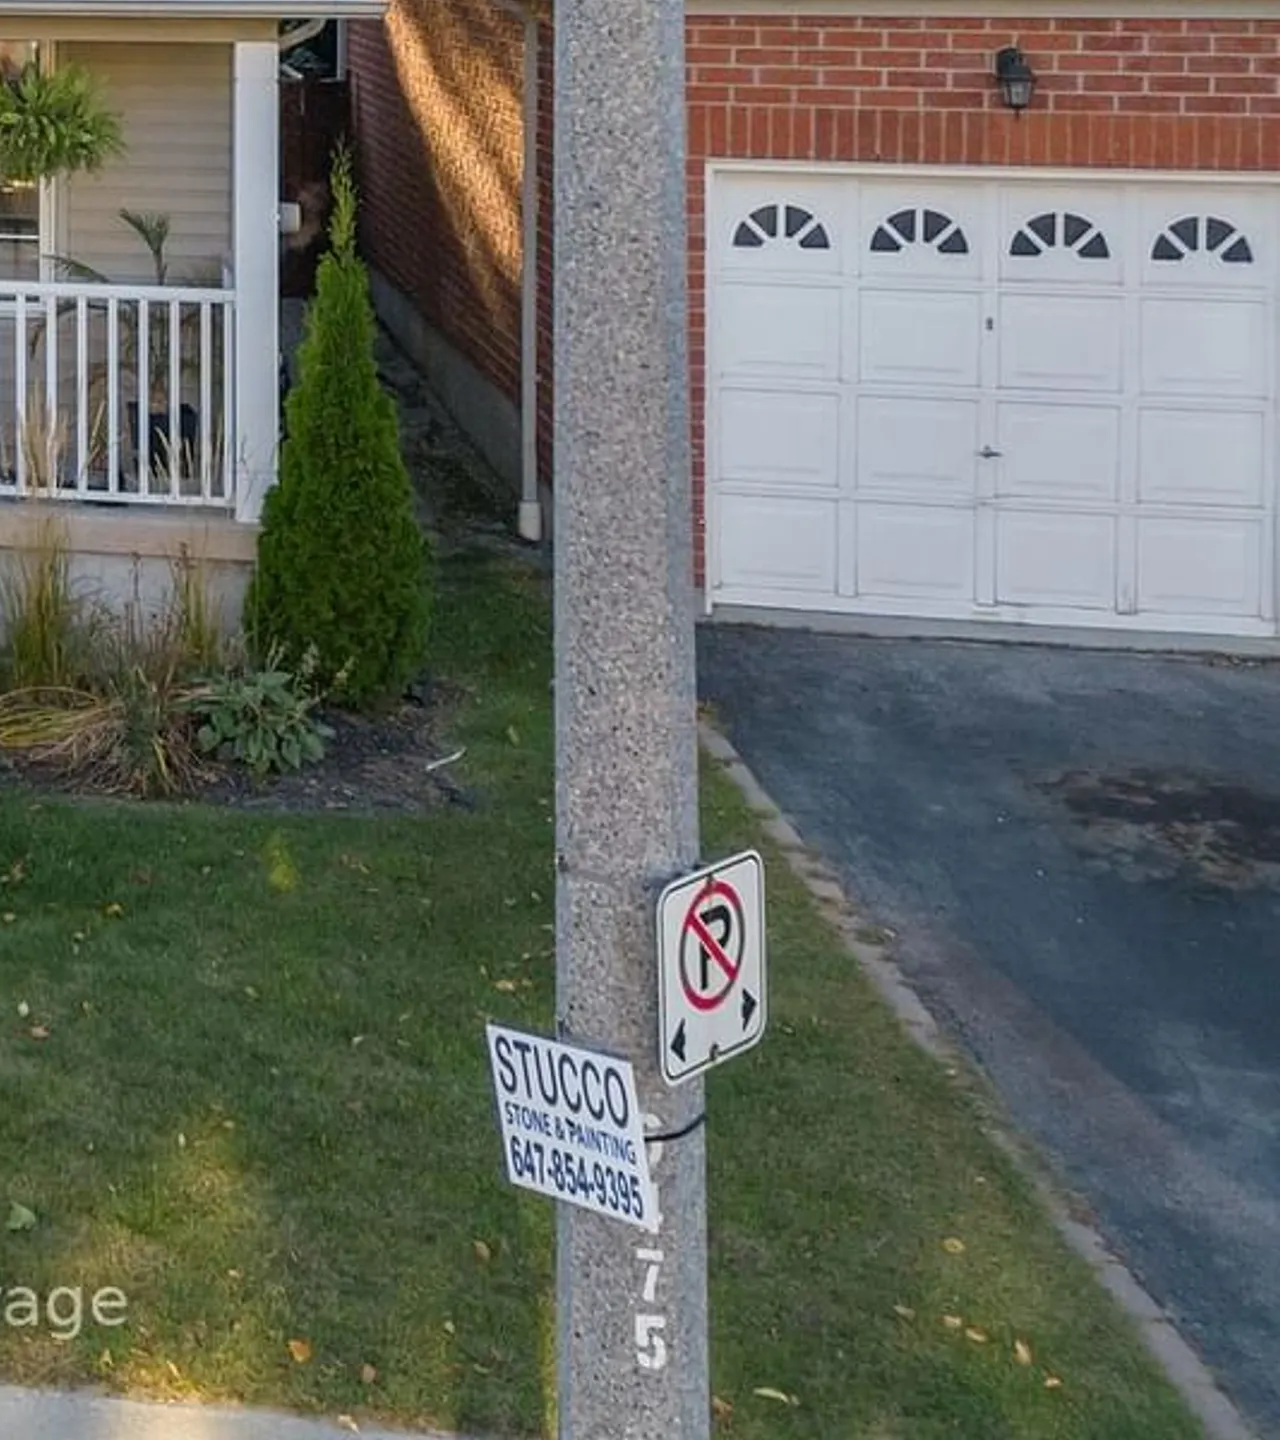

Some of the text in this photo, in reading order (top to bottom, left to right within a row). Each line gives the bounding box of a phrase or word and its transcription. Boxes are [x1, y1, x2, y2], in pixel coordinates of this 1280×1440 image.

[494, 1035, 630, 1130] STUCCO
[504, 1100, 637, 1166] STONE & PAINTING
[510, 1134, 644, 1221] 647-854-9395
